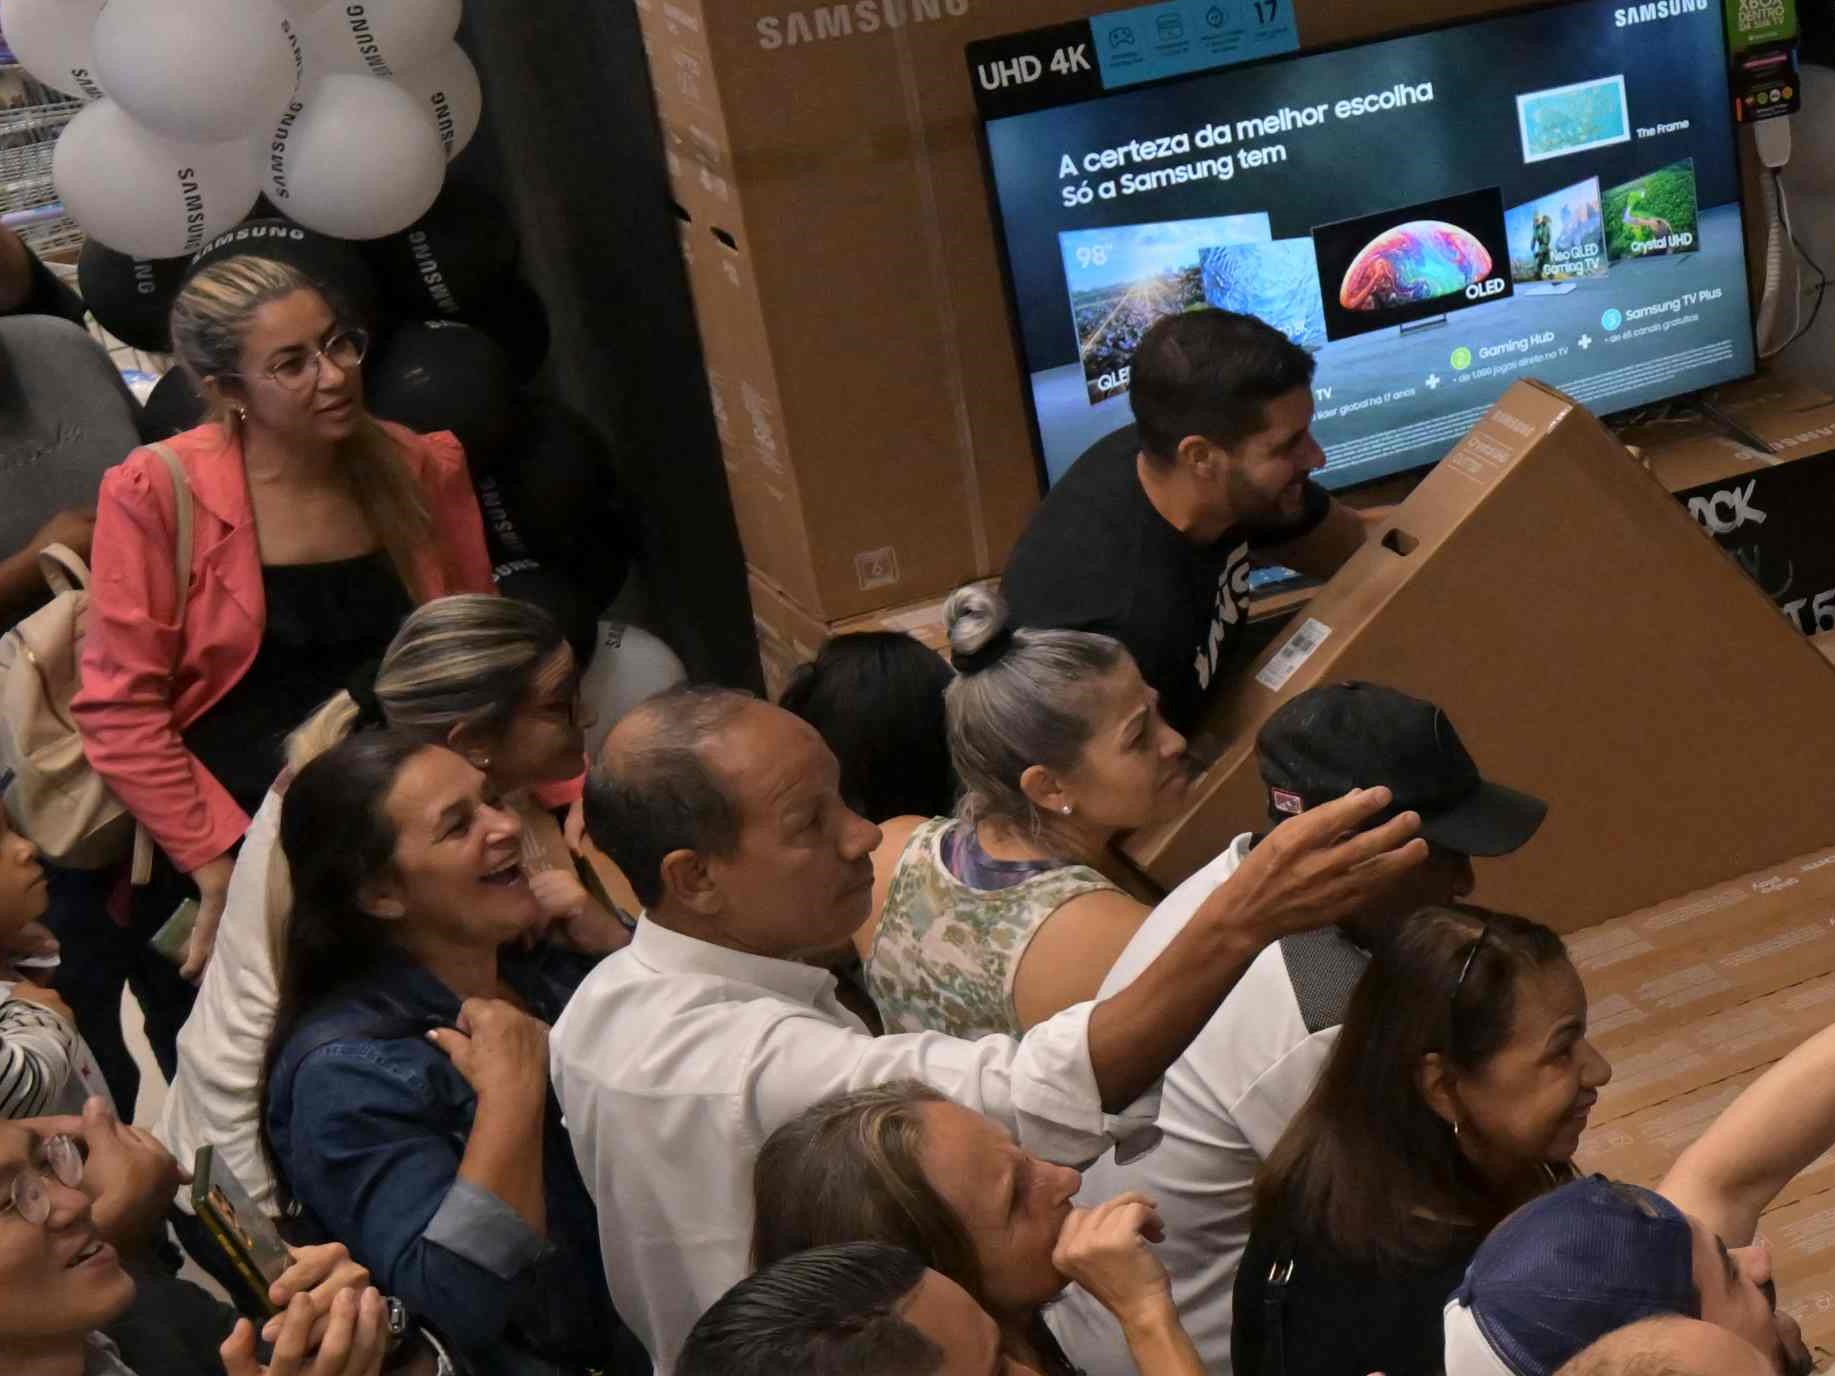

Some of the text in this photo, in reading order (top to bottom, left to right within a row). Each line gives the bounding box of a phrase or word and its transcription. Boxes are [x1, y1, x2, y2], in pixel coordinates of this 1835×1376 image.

[976, 43, 1092, 91] UHD 4K
[1058, 80, 1434, 179] A certeza da melhor escolha
[1657, 119, 1690, 135] Frame
[268, 101, 305, 200] SAMSUNG
[1061, 144, 1287, 208] Só a Samsung tem
[1571, 243, 1599, 259] QLED
[1668, 233, 1693, 248] UHD
[1465, 278, 1506, 300] OLED
[1625, 286, 1722, 323] Samsung TV Plus
[1478, 330, 1555, 361] Gaming Hub
[1316, 387, 1334, 401] TV
